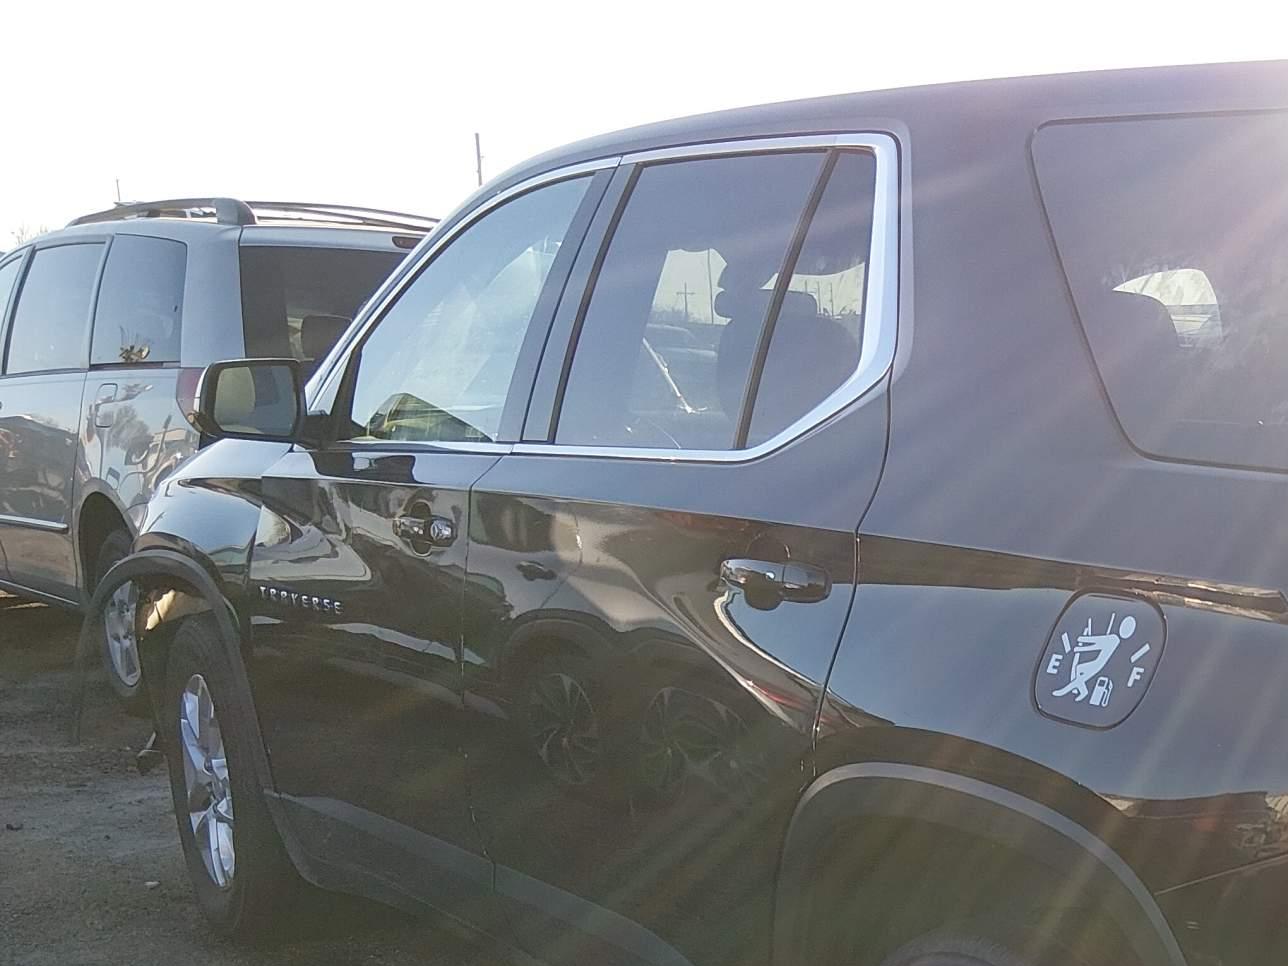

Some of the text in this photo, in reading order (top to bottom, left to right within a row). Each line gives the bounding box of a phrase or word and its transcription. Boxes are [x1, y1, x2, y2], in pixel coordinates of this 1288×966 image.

[260, 586, 344, 614] TRAVERSE
[1046, 653, 1063, 675] E
[1127, 666, 1145, 688] F
